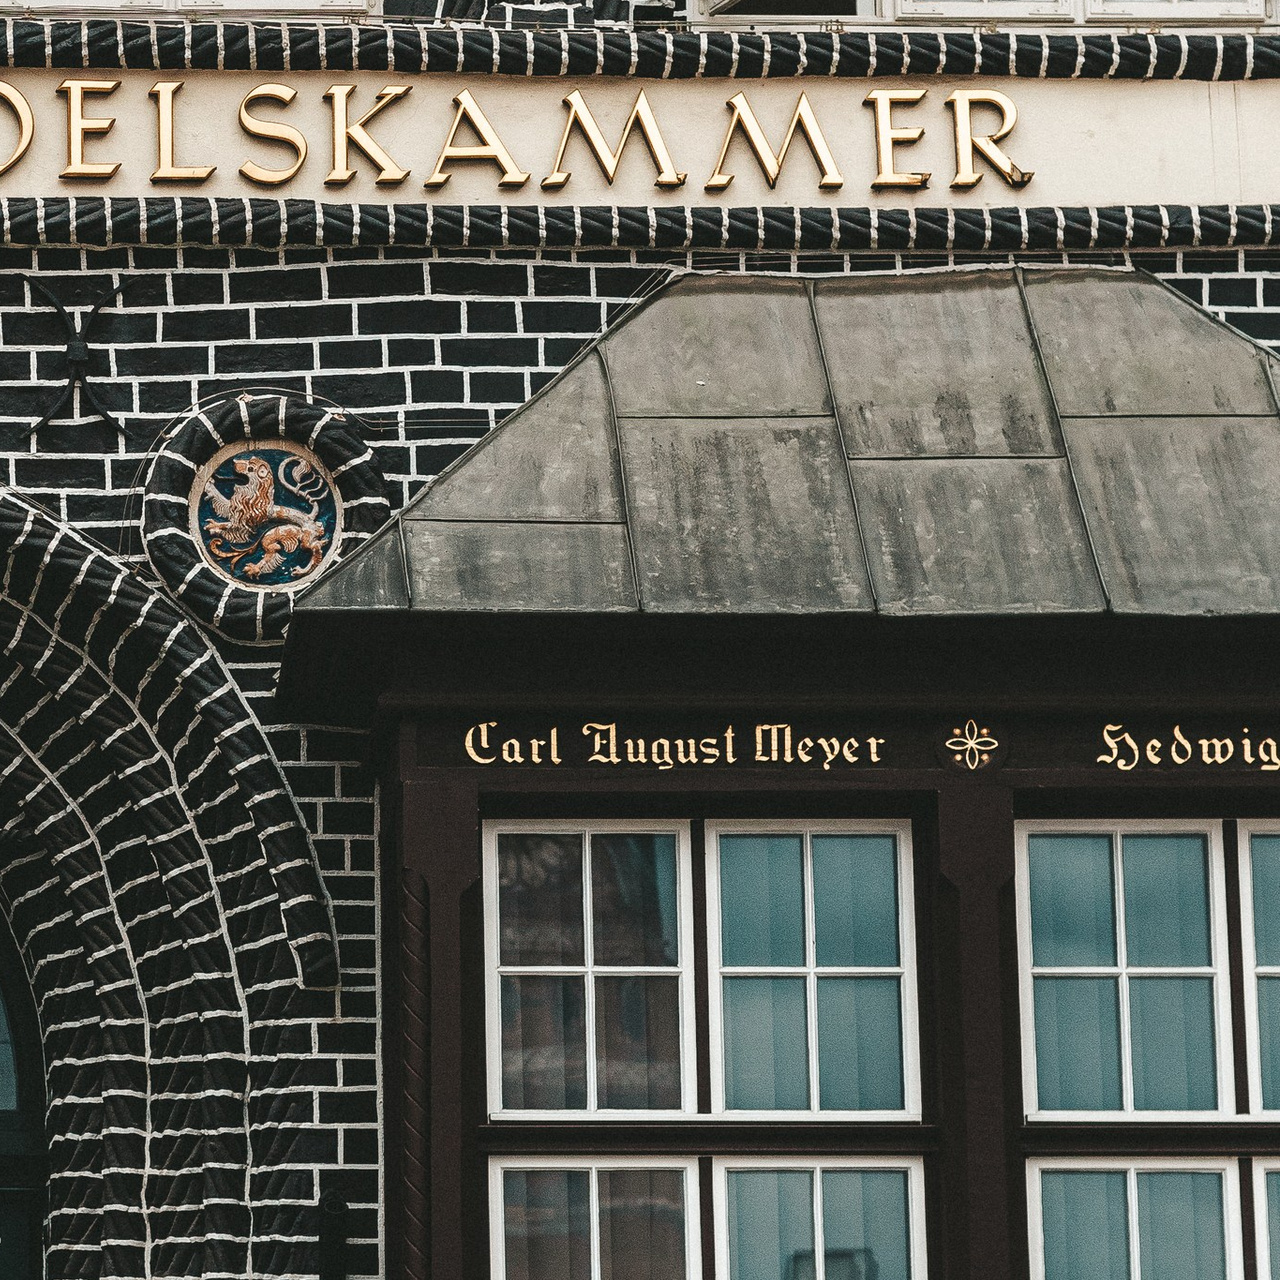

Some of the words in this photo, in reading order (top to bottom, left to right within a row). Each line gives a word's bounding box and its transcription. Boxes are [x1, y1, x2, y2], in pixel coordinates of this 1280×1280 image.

[464, 721, 562, 765] Carl
[582, 722, 737, 770] August
[754, 723, 886, 770] Meyer
[1097, 723, 1280, 771] Hedwig
